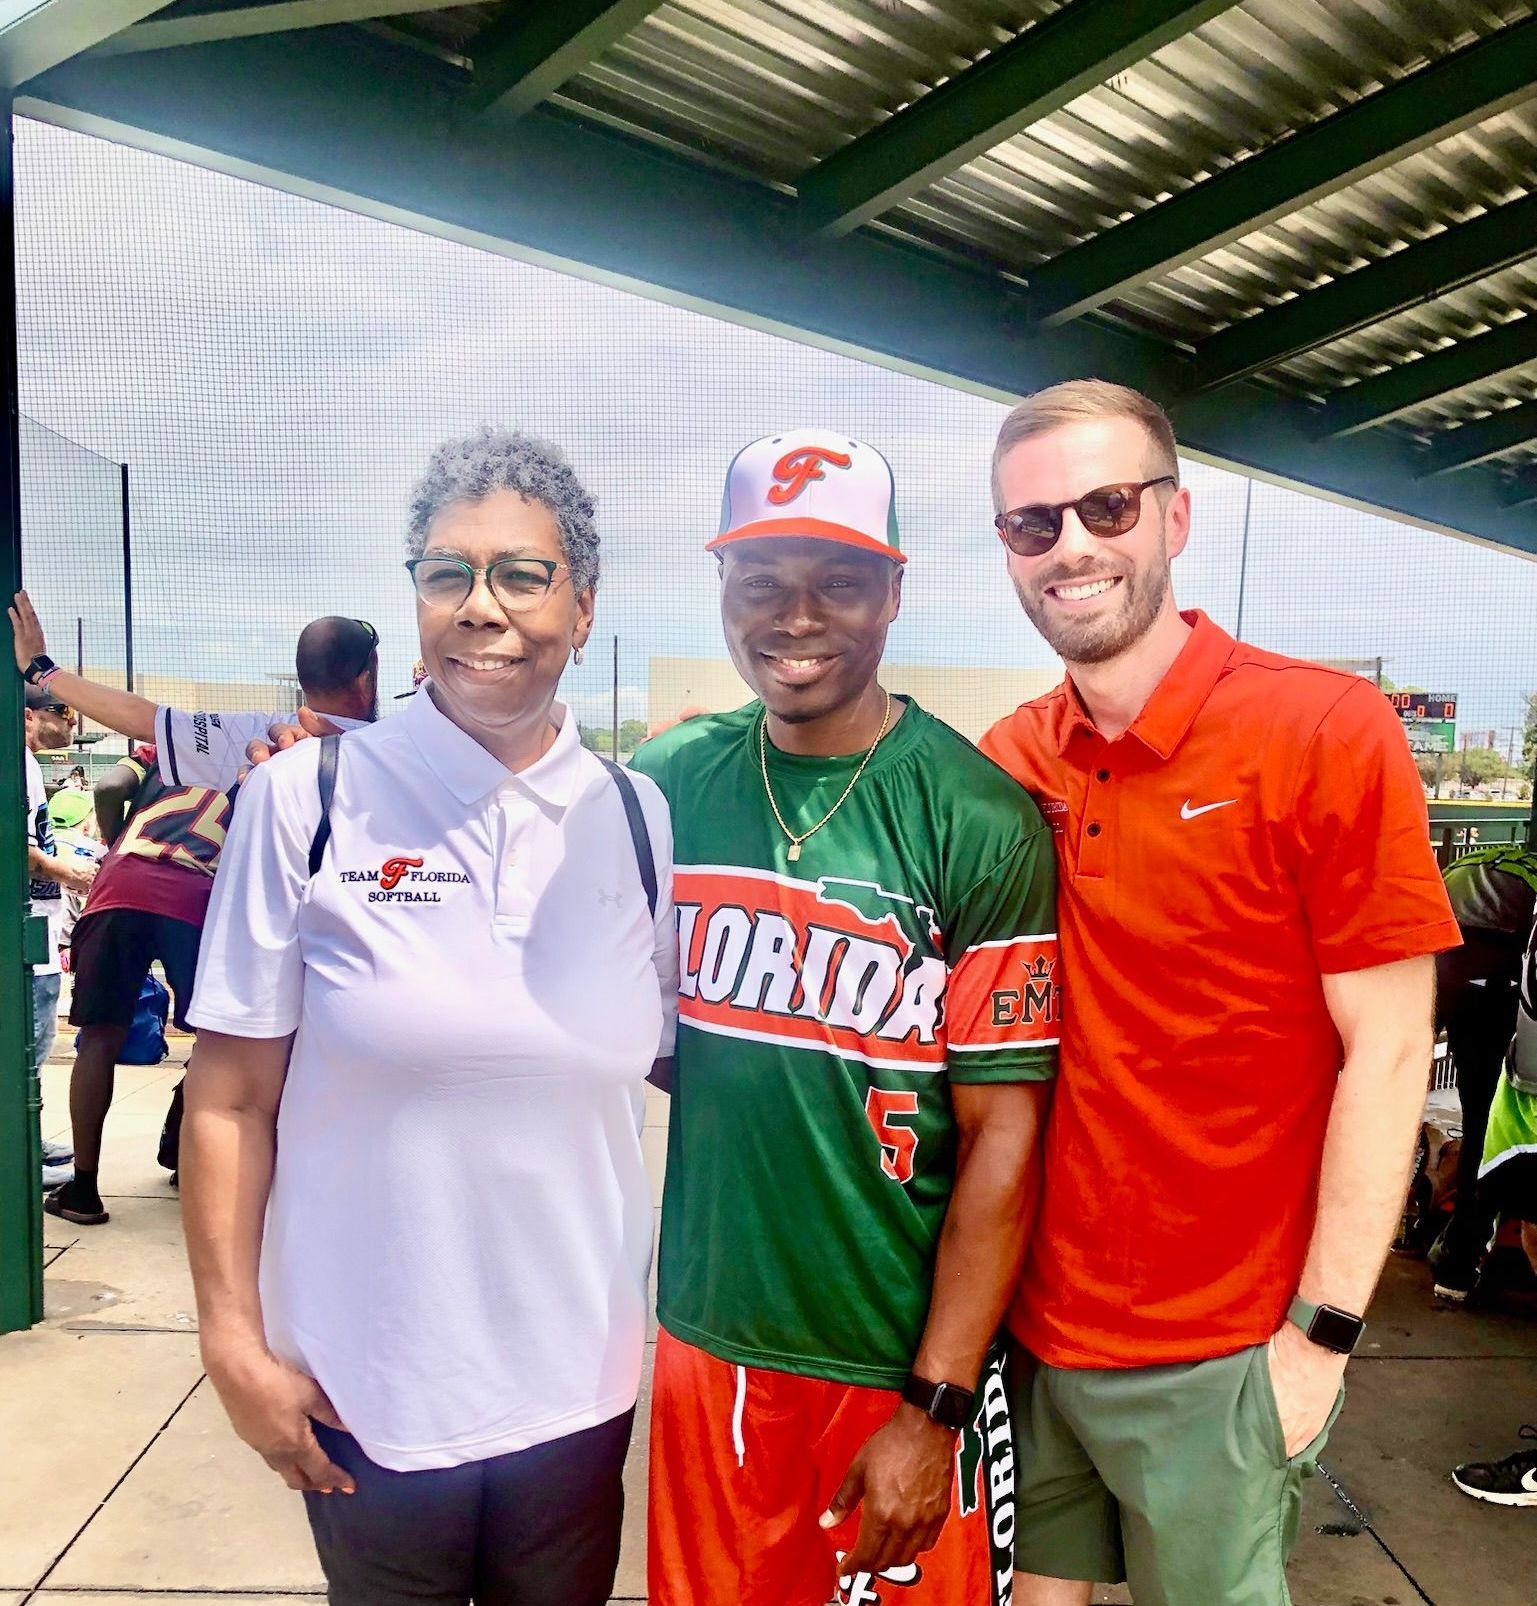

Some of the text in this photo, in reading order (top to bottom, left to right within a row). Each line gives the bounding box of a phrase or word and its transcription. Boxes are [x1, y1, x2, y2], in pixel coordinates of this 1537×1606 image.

[767, 446, 852, 507] F
[1428, 693, 1457, 703] HOME
[340, 870, 379, 882] TEAM
[411, 871, 470, 883] FLORIDA
[368, 891, 441, 902] SOFTBALL
[674, 902, 948, 1045] LORIDA
[864, 1085, 919, 1184] 5
